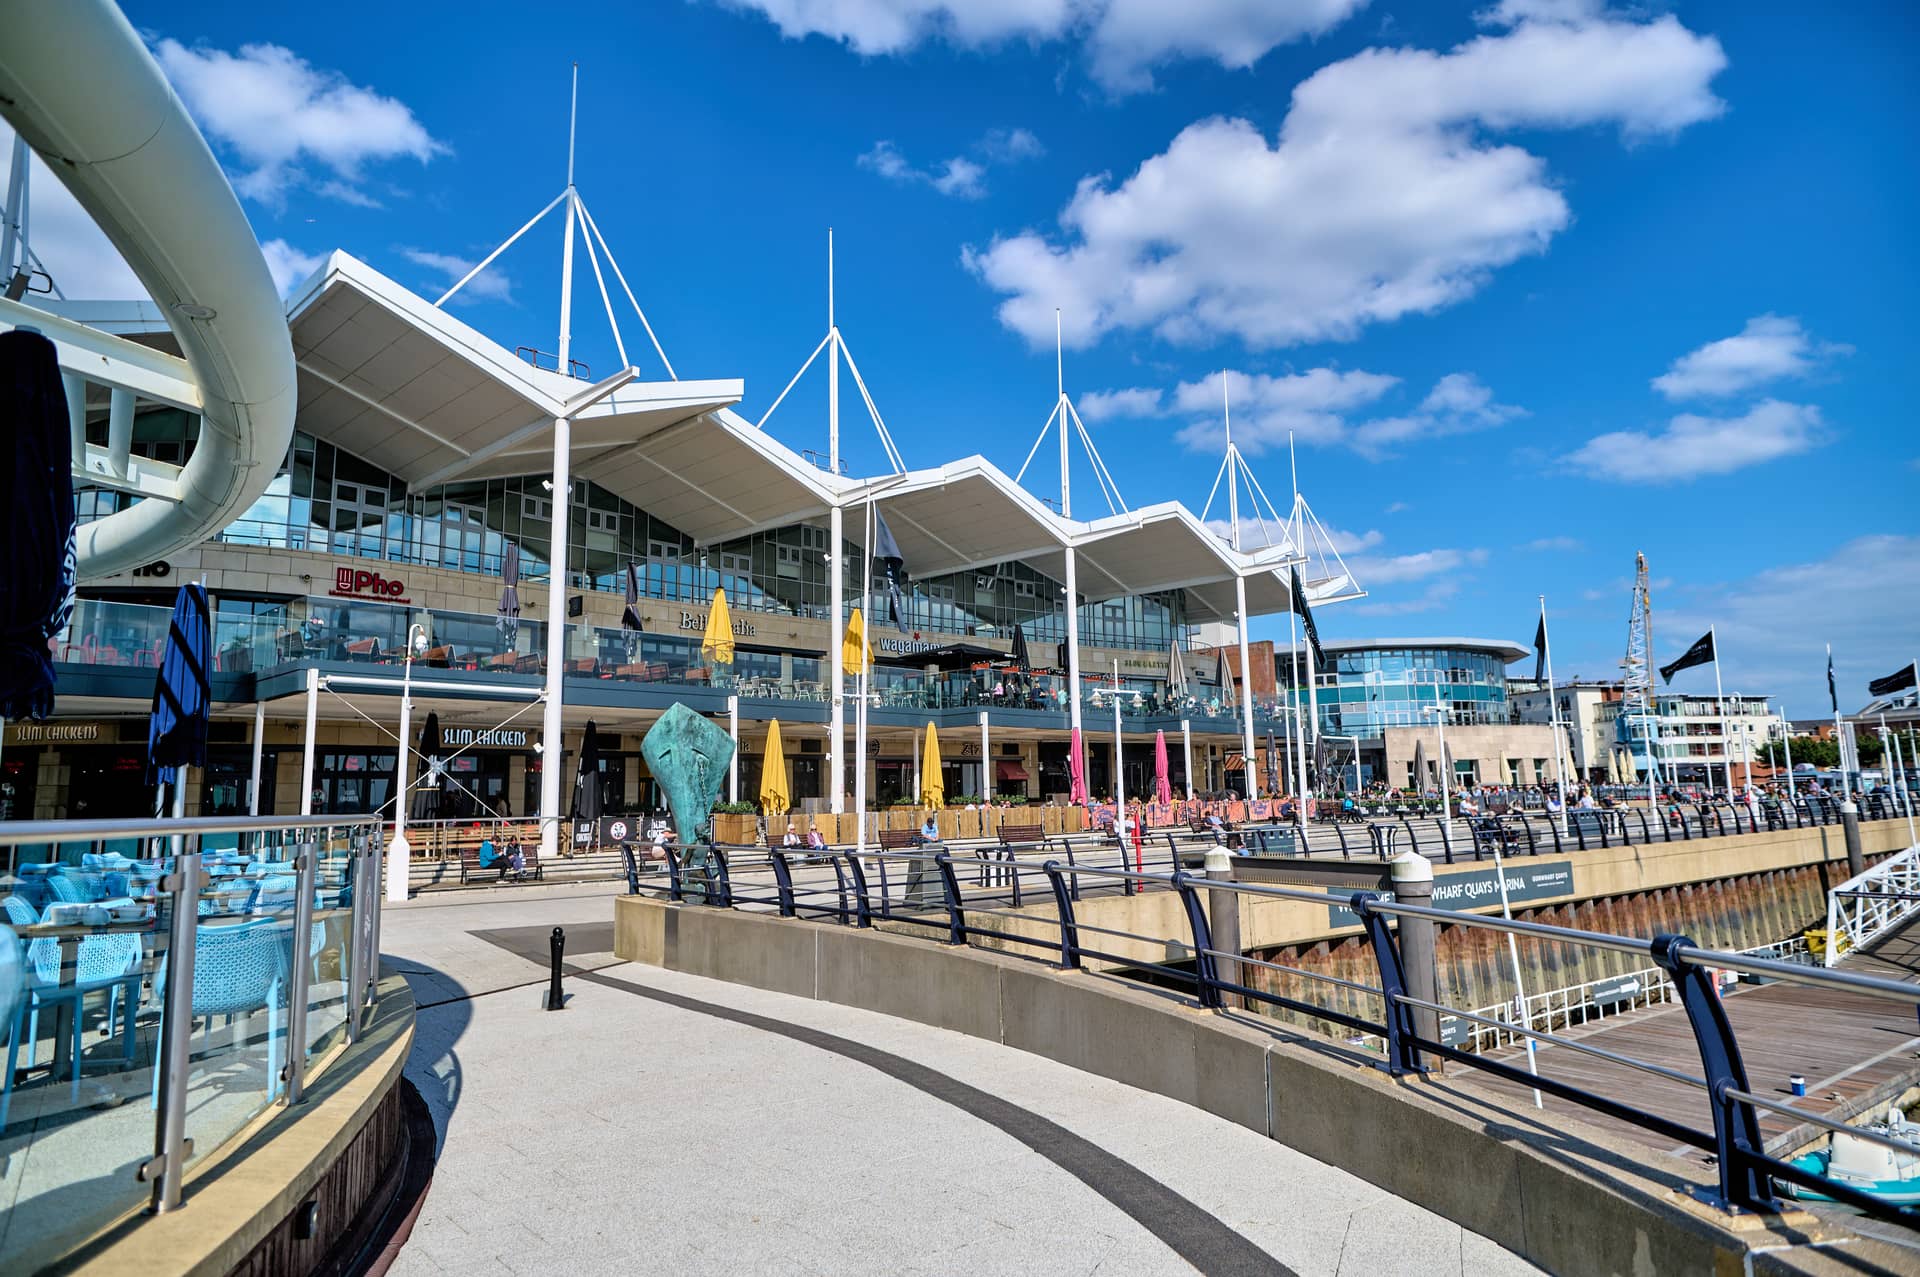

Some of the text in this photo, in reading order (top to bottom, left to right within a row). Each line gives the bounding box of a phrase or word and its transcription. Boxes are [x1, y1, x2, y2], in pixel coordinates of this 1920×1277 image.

[354, 570, 404, 596] Pho
[679, 611, 756, 636] Bell alia
[880, 638, 945, 655] wagamam
[16, 725, 99, 741] SLIM CHICKENS
[443, 728, 526, 746] SLIM CHICKENS
[1431, 877, 1526, 901] WHARF QUAYS MRINA
